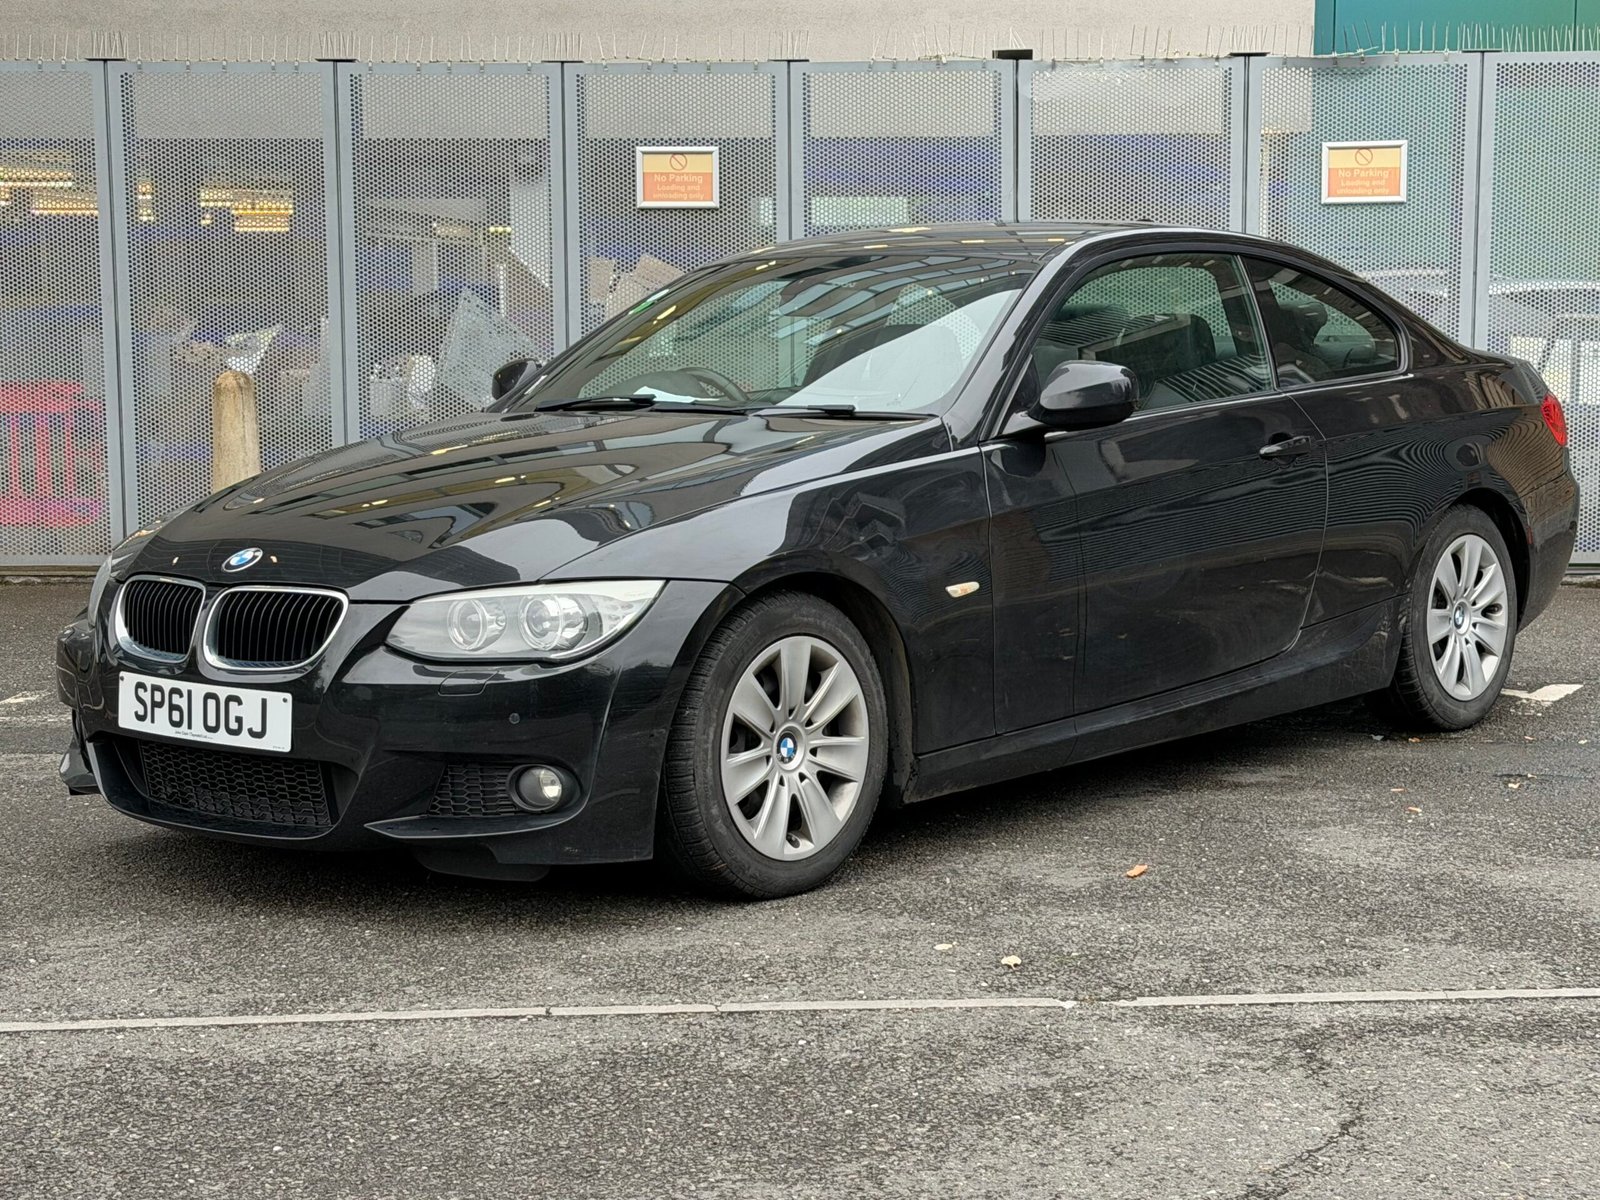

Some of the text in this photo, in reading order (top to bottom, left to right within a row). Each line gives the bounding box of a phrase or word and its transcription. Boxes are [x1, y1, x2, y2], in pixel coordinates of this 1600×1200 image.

[1338, 168, 1389, 179] No Parking
[654, 173, 703, 184] No Parking
[1341, 179, 1370, 187] Loading
[656, 184, 686, 192] Loading
[1336, 187, 1389, 195] unloading only
[134, 681, 267, 739] SP61 OGJ
